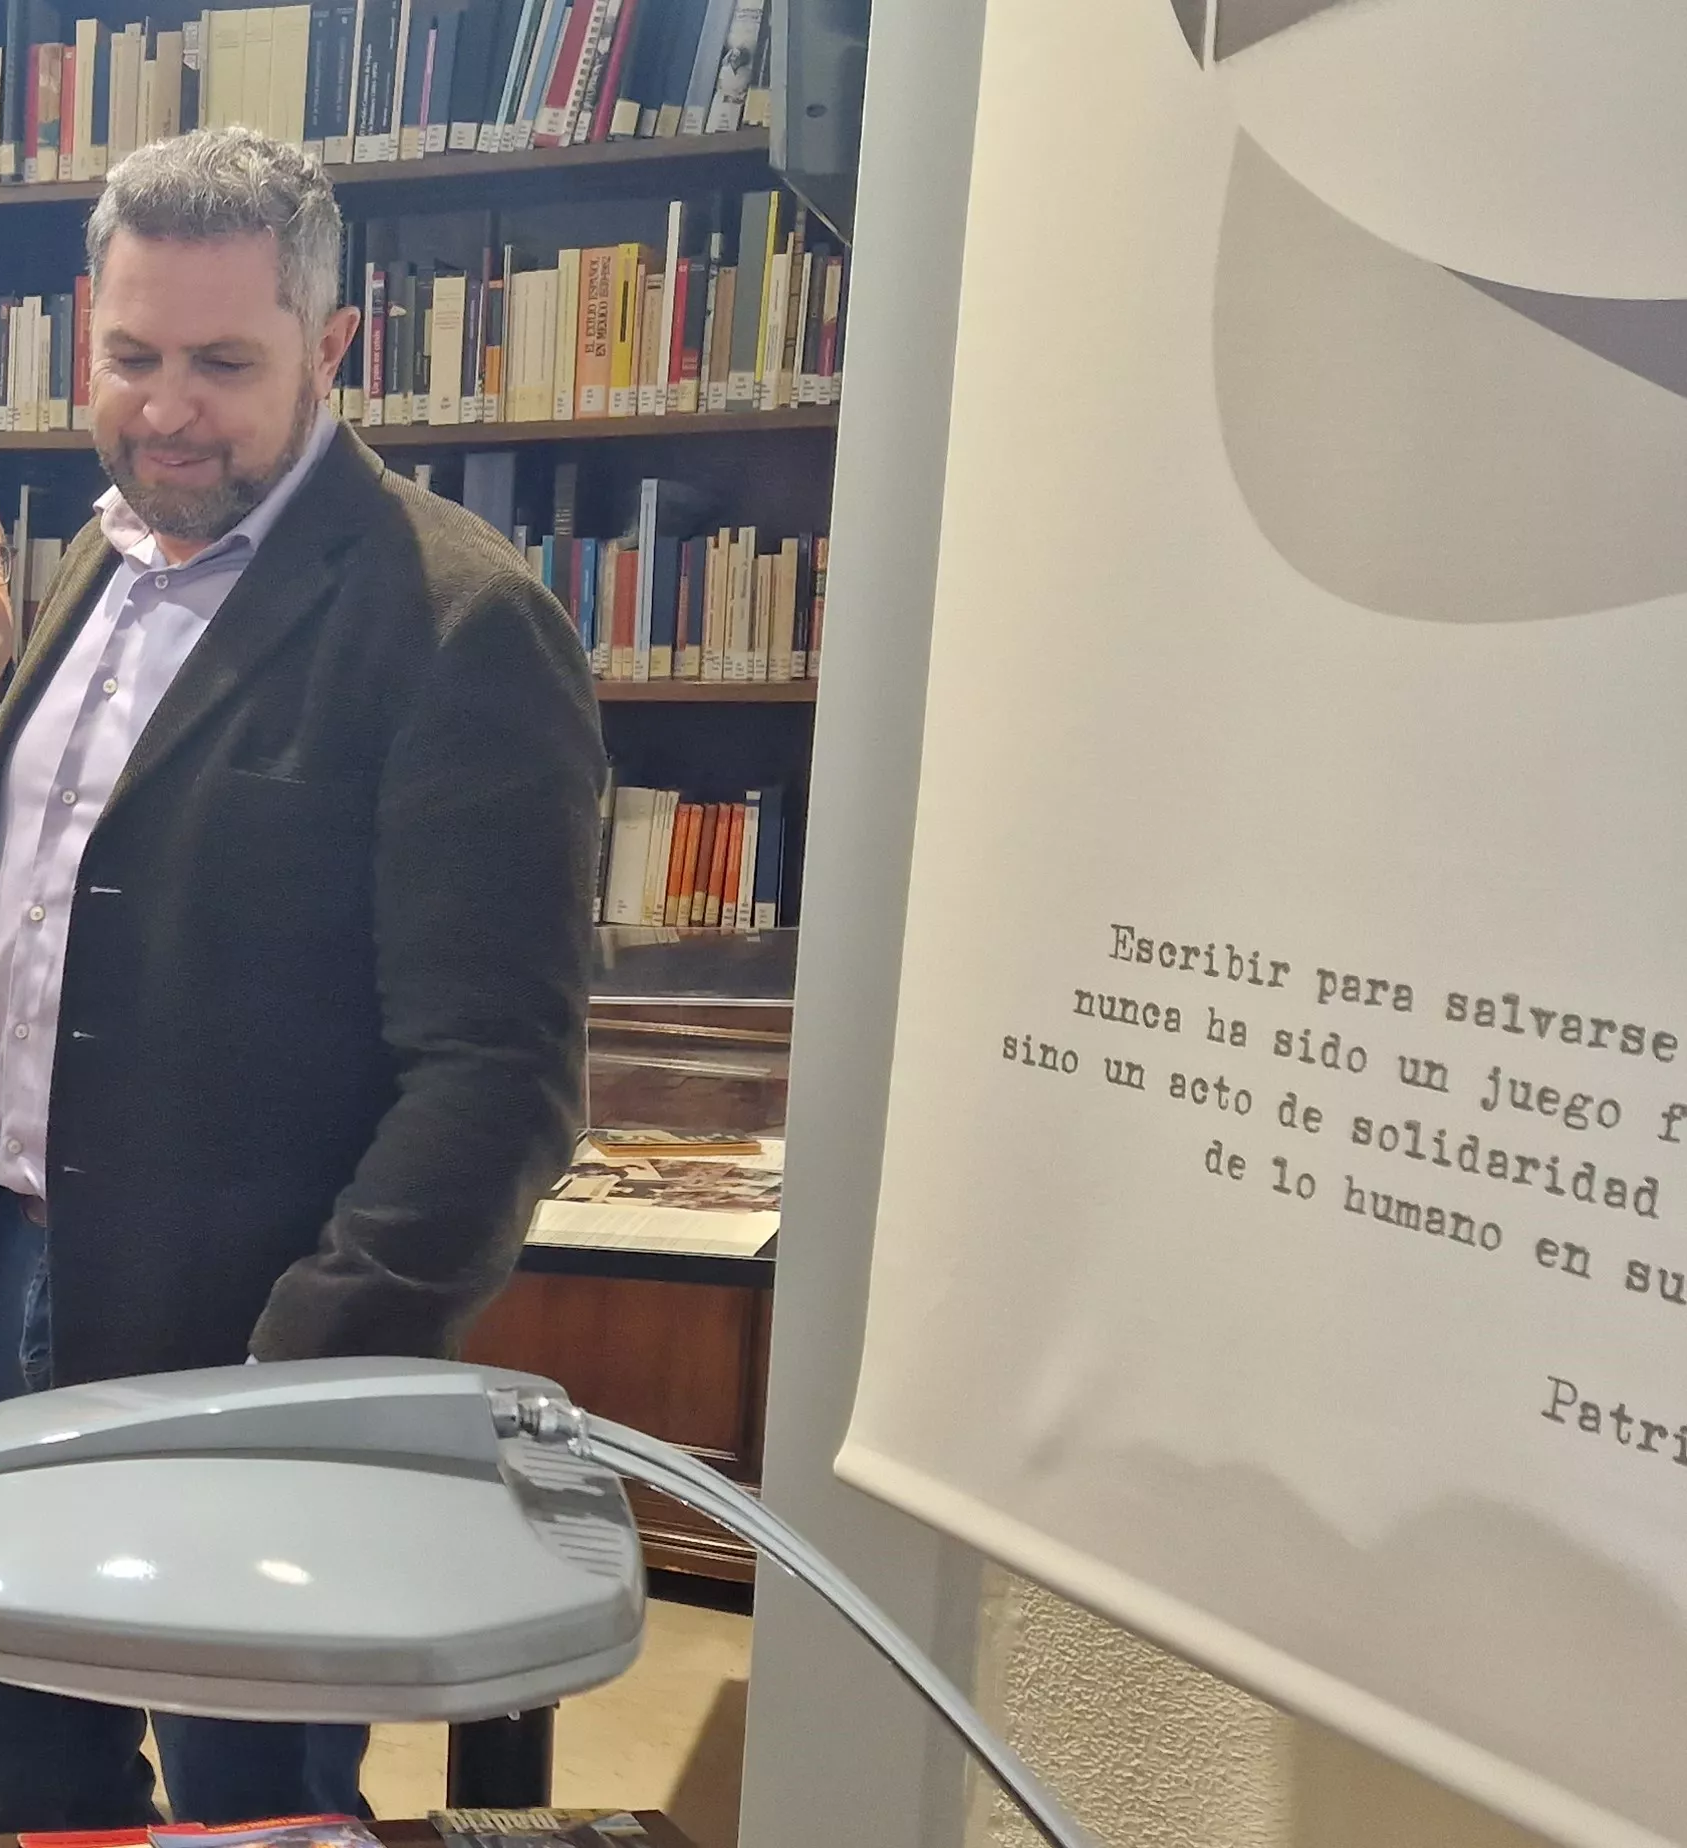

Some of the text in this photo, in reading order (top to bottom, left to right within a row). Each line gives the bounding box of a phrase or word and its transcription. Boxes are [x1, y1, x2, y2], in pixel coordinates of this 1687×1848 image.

[1073, 988, 1182, 1034] nunca
[1207, 1007, 1248, 1049] ha
[1274, 1029, 1369, 1075] sido
[1398, 1054, 1451, 1095] un
[1480, 1064, 1623, 1132] juego
[1109, 923, 1680, 1065] Escribir para salvarse
[1003, 1033, 1661, 1221] sino un acto de solidaridad
[1205, 1140, 1687, 1307] de lo humano en su
[1541, 1376, 1687, 1468] Patri
